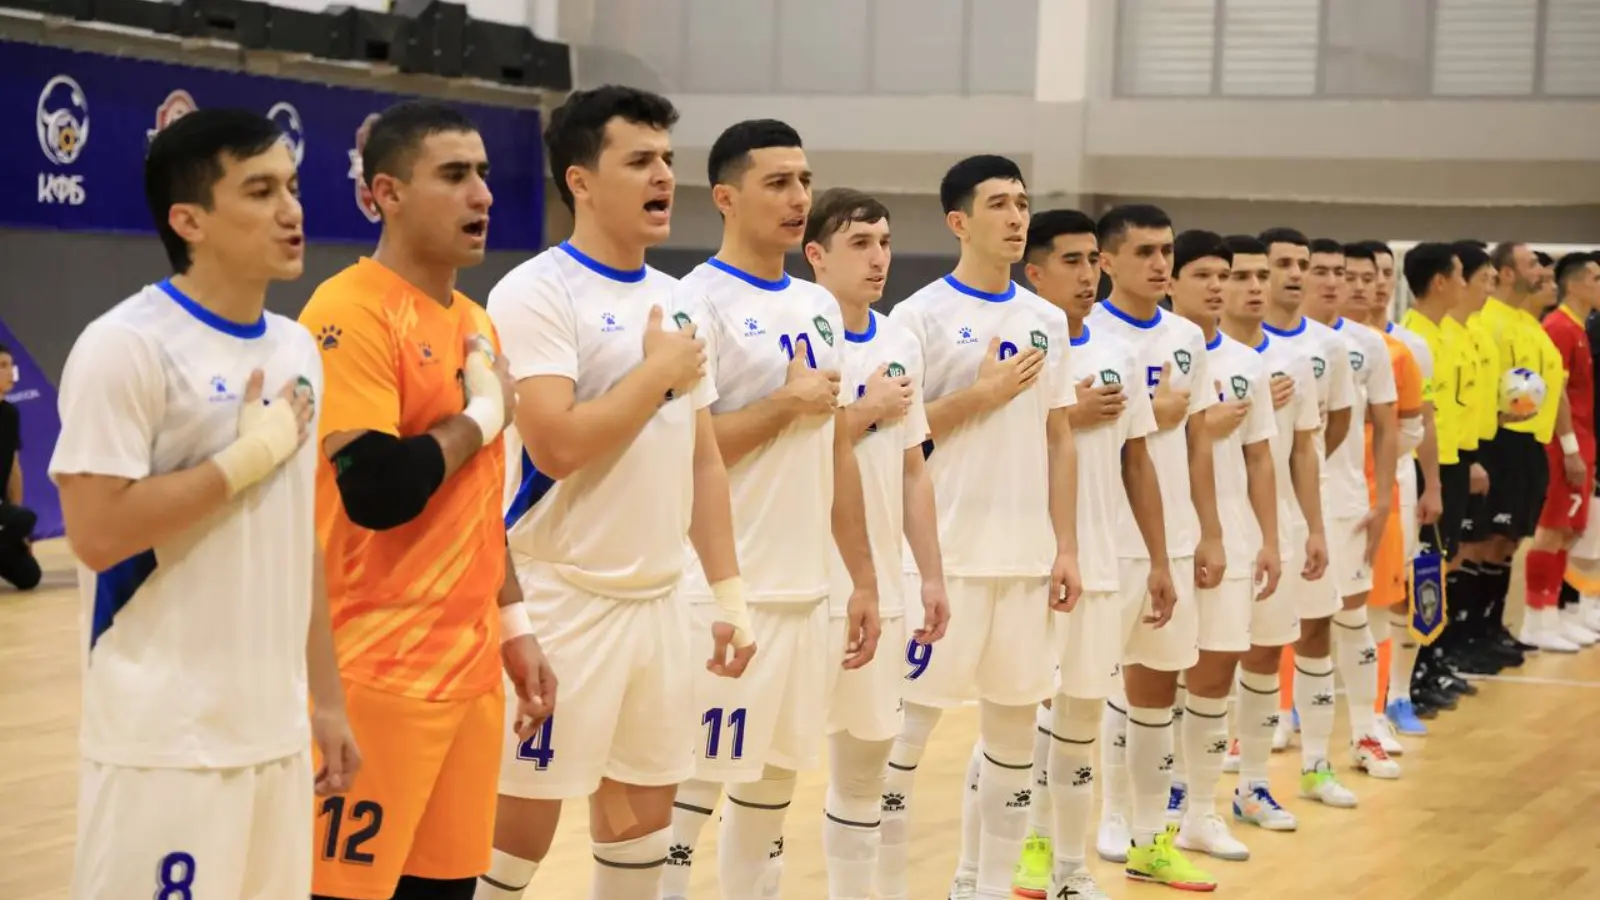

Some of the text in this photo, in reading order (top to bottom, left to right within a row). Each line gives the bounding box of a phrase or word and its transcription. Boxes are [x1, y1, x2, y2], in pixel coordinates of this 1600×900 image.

[37, 172, 86, 205] КФБ
[1568, 493, 1582, 518] 7
[905, 636, 933, 681] 9
[517, 713, 555, 771] 4
[702, 708, 747, 760] 11
[319, 796, 384, 867] 12
[155, 851, 196, 900] 8
